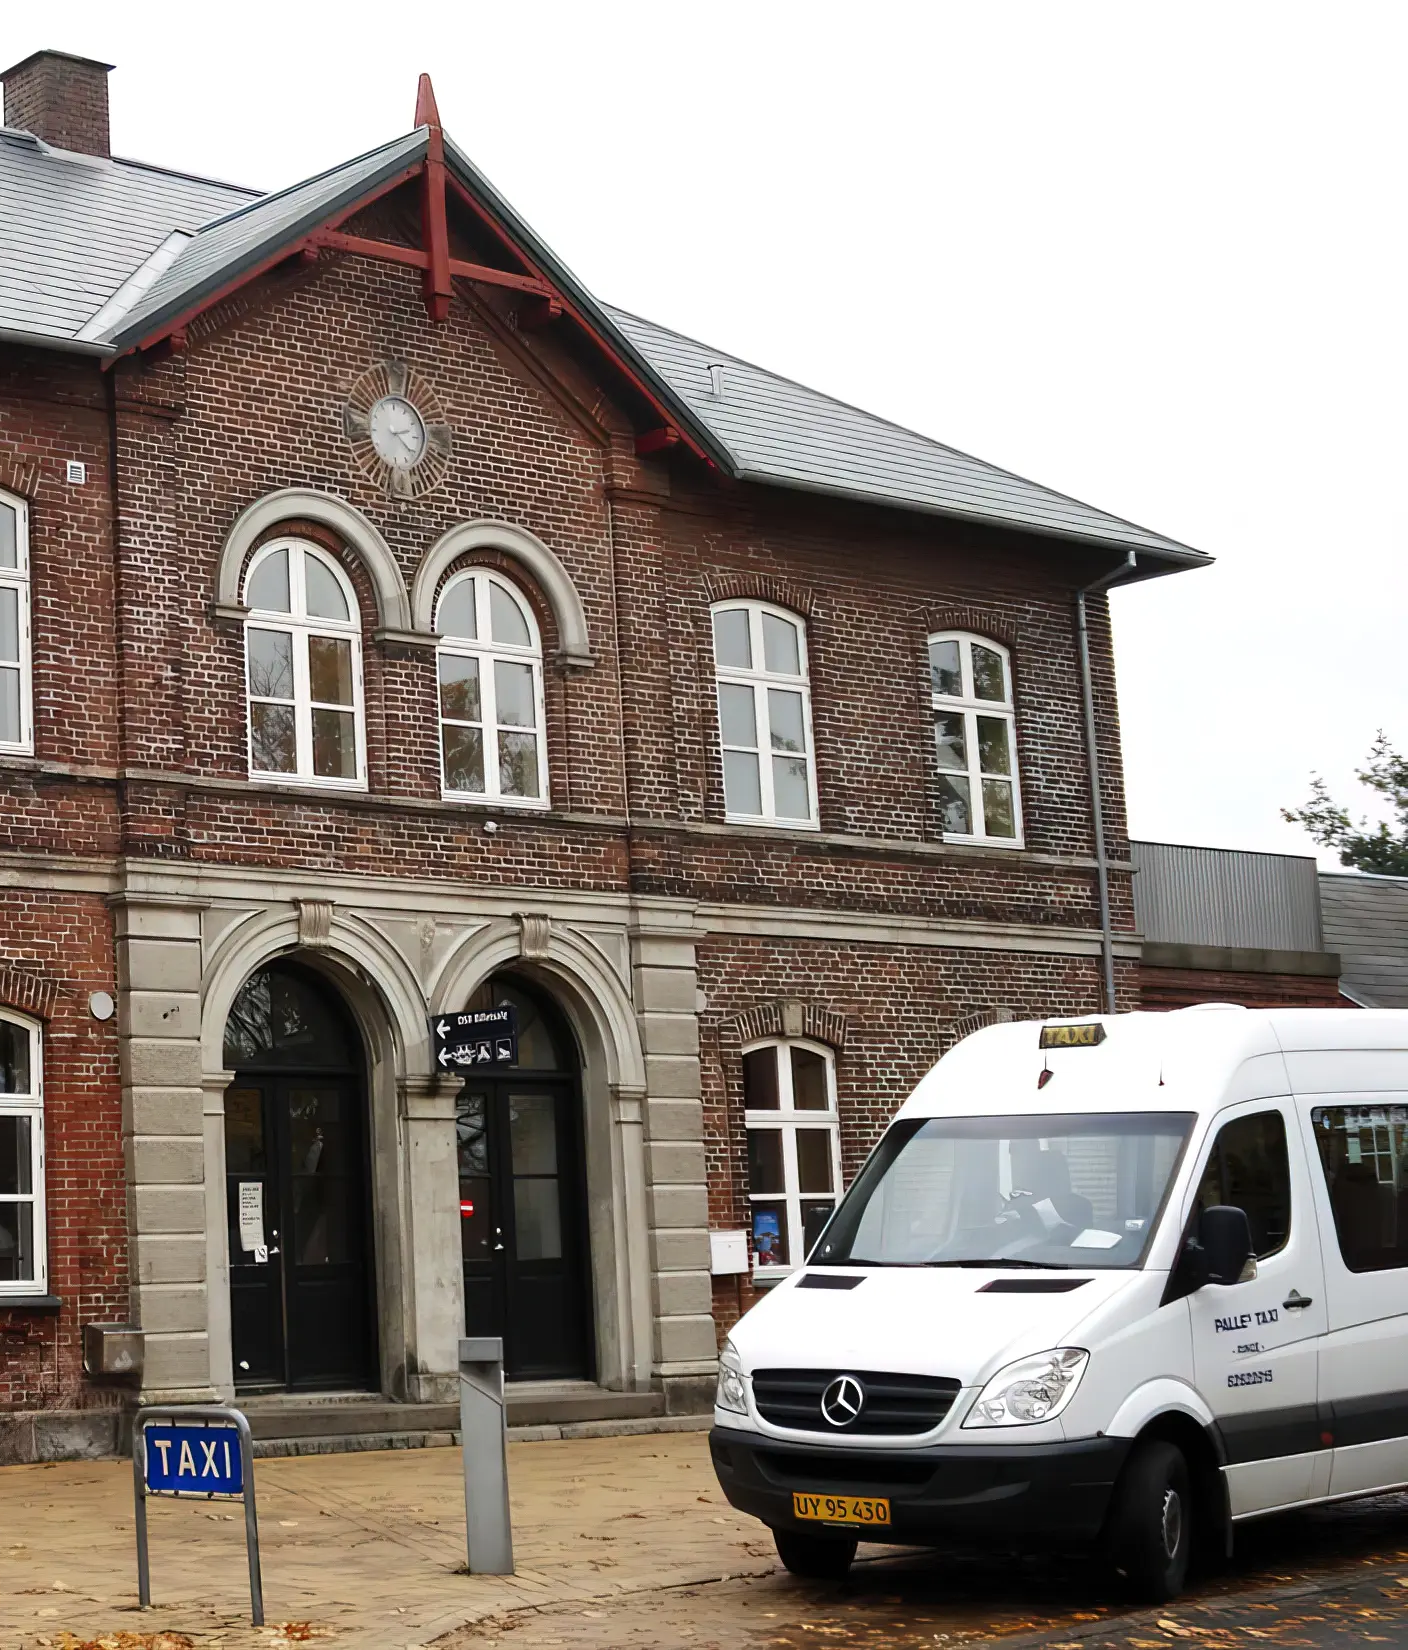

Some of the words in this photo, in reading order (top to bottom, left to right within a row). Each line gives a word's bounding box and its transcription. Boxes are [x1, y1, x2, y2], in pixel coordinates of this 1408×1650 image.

[1043, 1025, 1097, 1045] TAXI
[1254, 1308, 1279, 1326] TAXI
[154, 1440, 232, 1479] TAXI
[795, 1496, 821, 1517] UY
[825, 1498, 847, 1518] 95
[852, 1501, 888, 1522] 430
